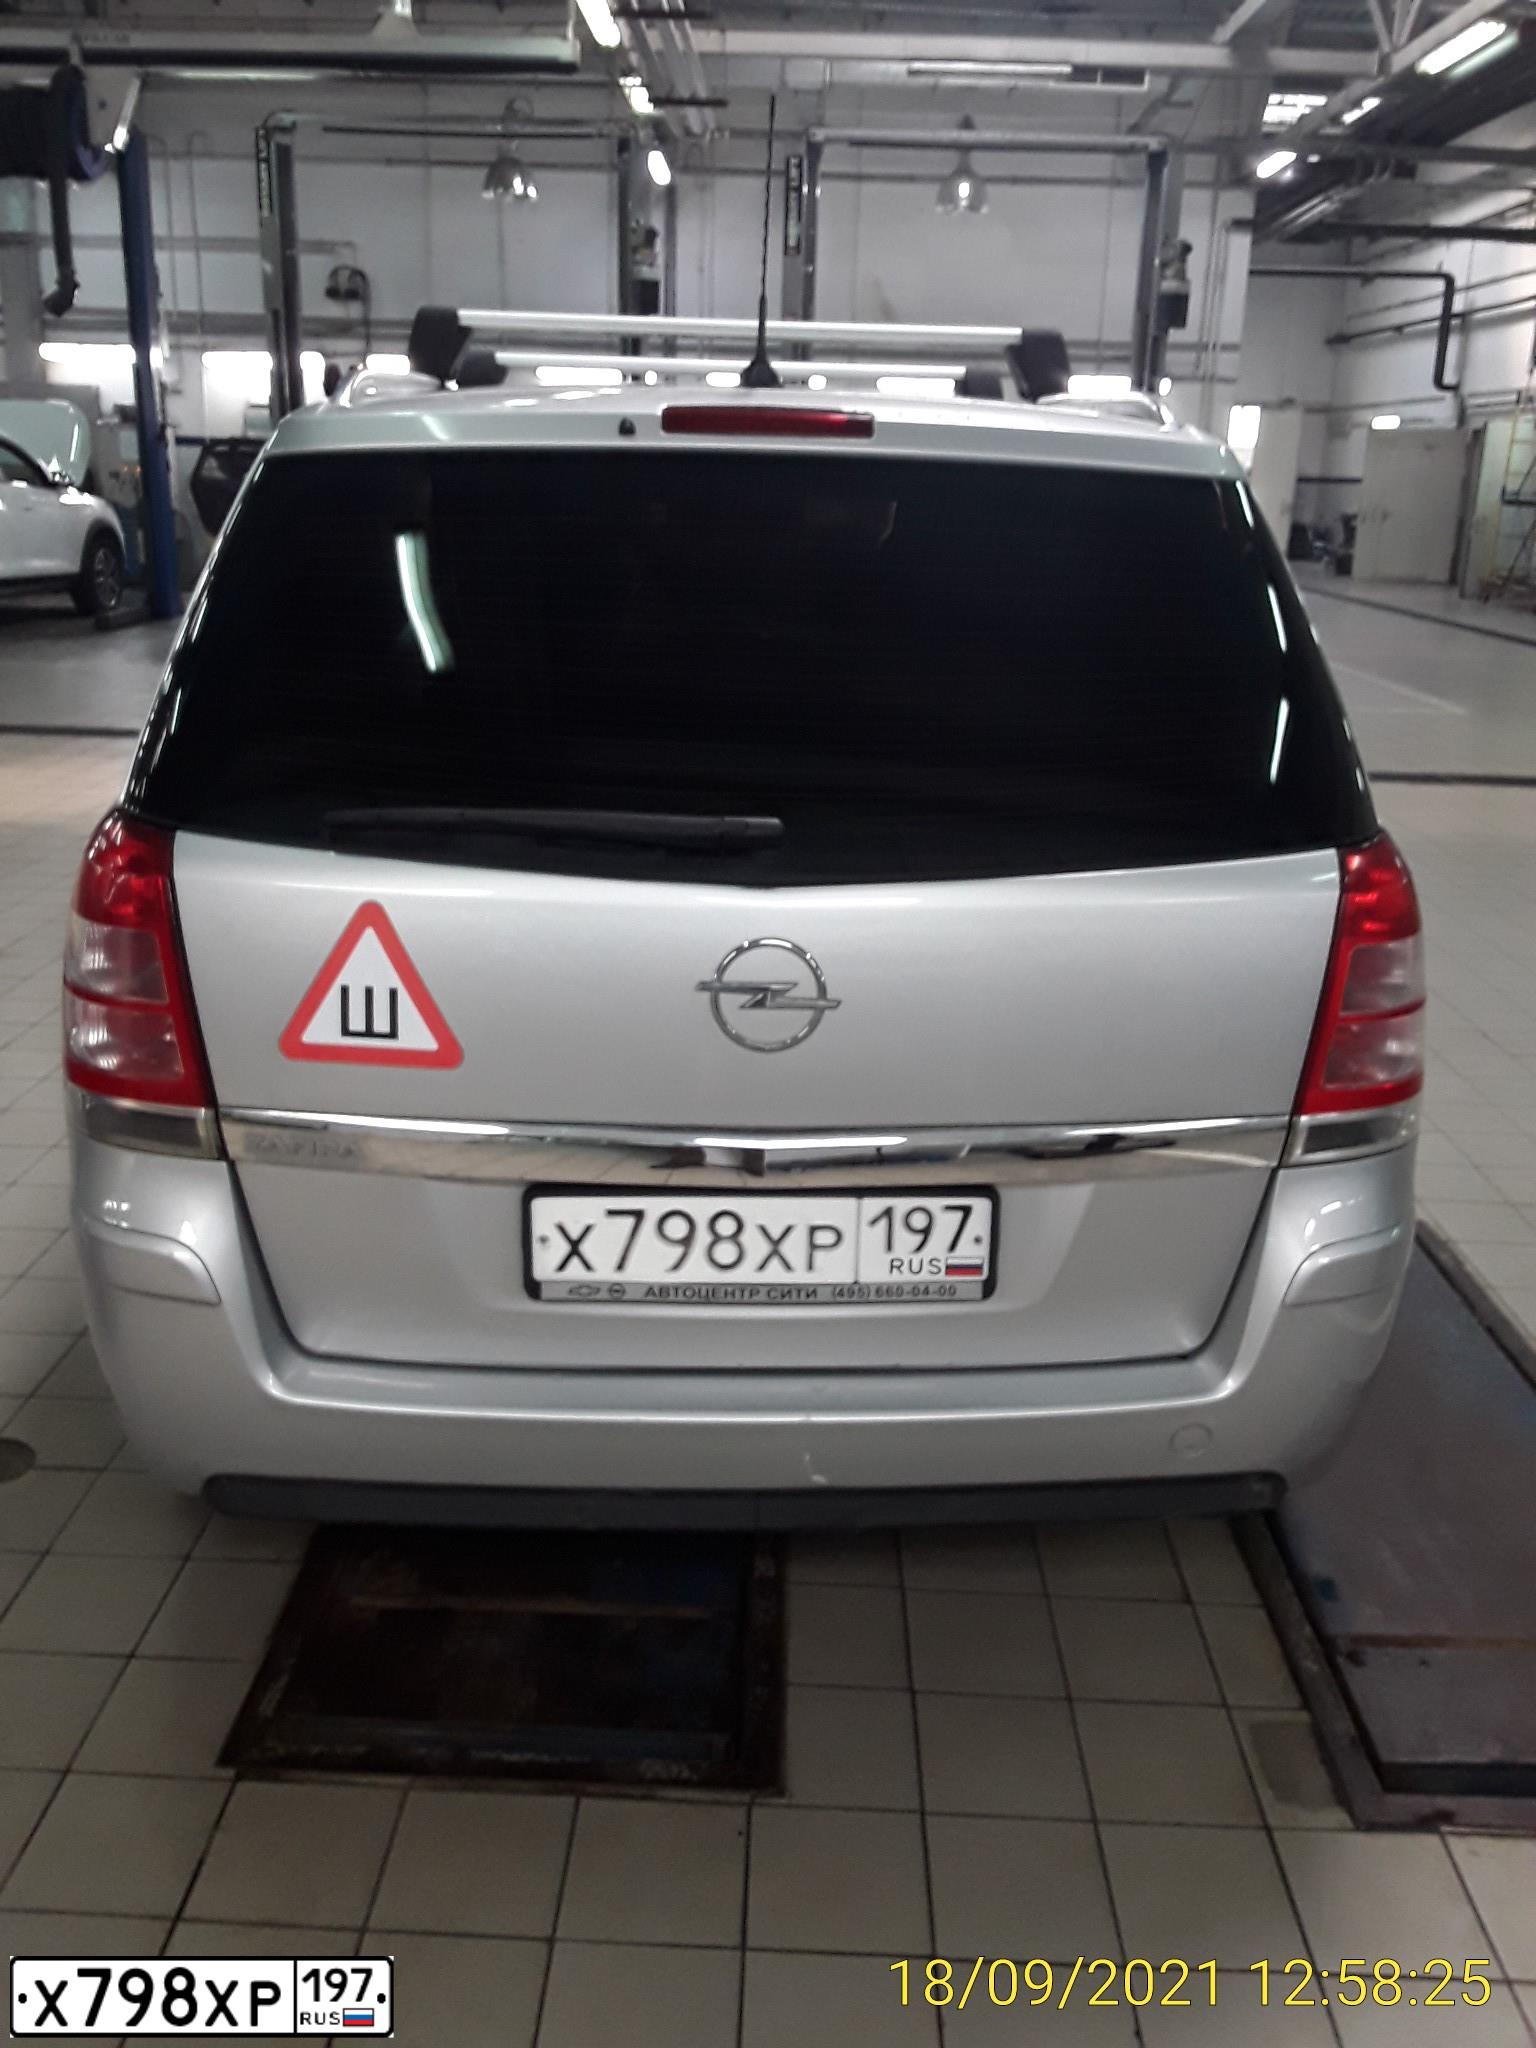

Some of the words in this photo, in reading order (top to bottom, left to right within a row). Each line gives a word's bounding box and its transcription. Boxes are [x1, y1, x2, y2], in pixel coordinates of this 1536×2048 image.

[340, 984, 399, 1039] Ш
[868, 1204, 974, 1254] 197
[889, 1258, 942, 1276] RUS
[767, 1286, 817, 1300] СИТИ
